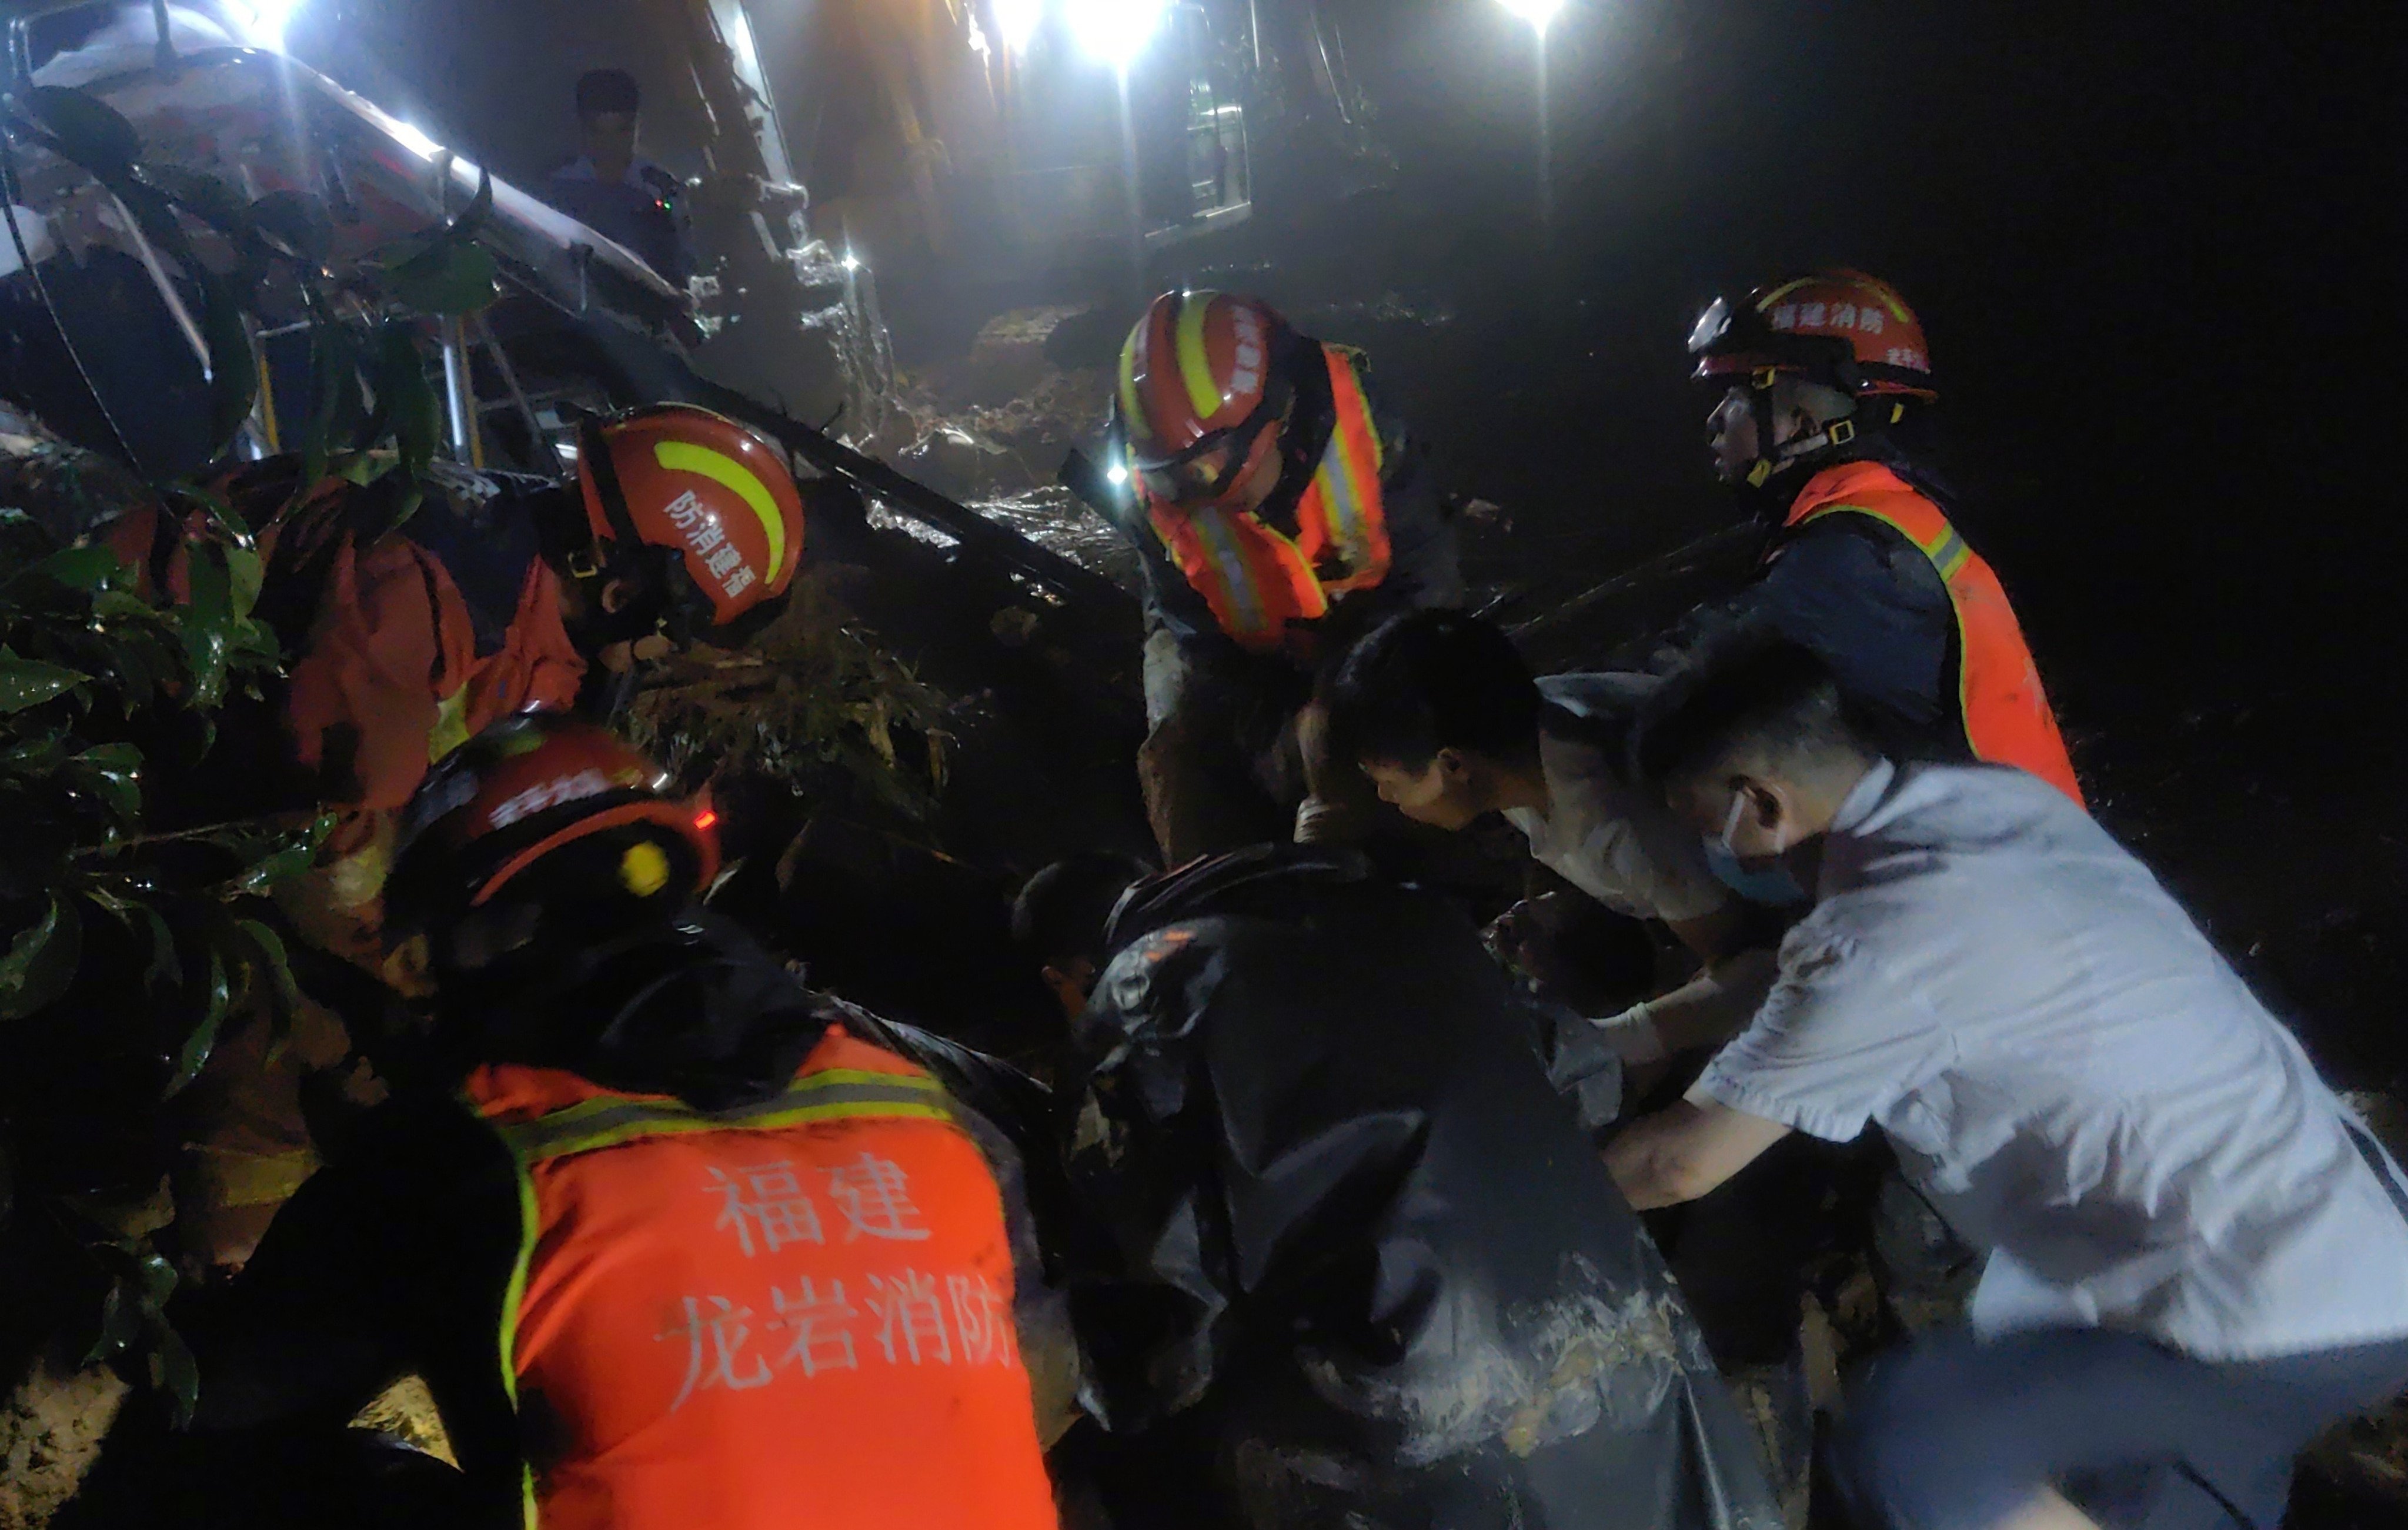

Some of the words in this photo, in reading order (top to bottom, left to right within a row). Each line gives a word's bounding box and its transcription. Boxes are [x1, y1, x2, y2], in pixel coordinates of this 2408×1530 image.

[702, 1151, 932, 1258] 福建
[652, 1267, 1011, 1414] 龙岩消防
